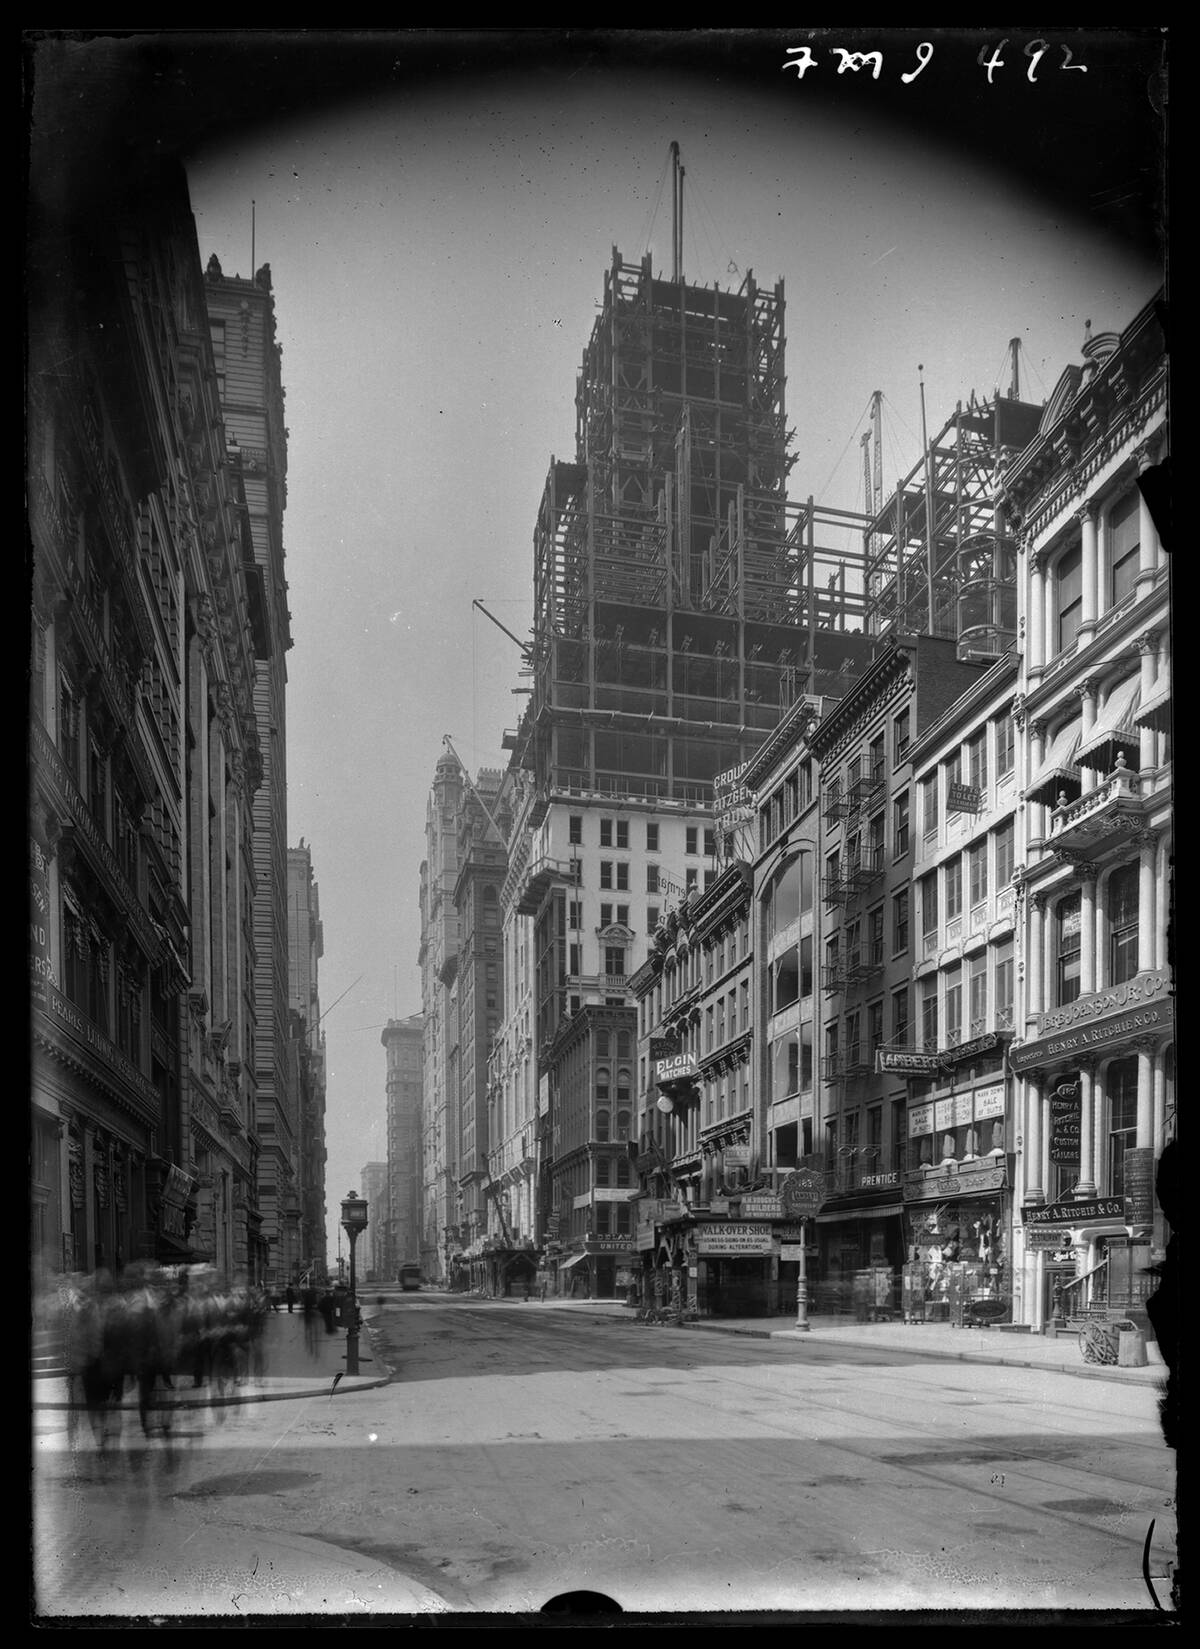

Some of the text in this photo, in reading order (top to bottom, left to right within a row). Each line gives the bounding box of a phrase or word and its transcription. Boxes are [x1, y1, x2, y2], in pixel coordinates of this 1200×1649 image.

[1047, 1036, 1079, 1056] HENRY
[1091, 1018, 1133, 1042] RITCHIE
[1133, 1015, 1143, 1027] &
[656, 1051, 697, 1076] ELGIN
[660, 1065, 692, 1081] WATCHES
[983, 1096, 998, 1106] SALE
[914, 1115, 928, 1125] SALE
[1053, 1136, 1080, 1146] CUSTOM
[861, 1172, 897, 1187] PRENTICE
[745, 1204, 781, 1212] BUILDERS
[1026, 1210, 1051, 1222] HENRY
[1061, 1206, 1097, 1218] RITCHIE
[1098, 1203, 1106, 1214] &
[749, 1225, 771, 1235] SHOE
